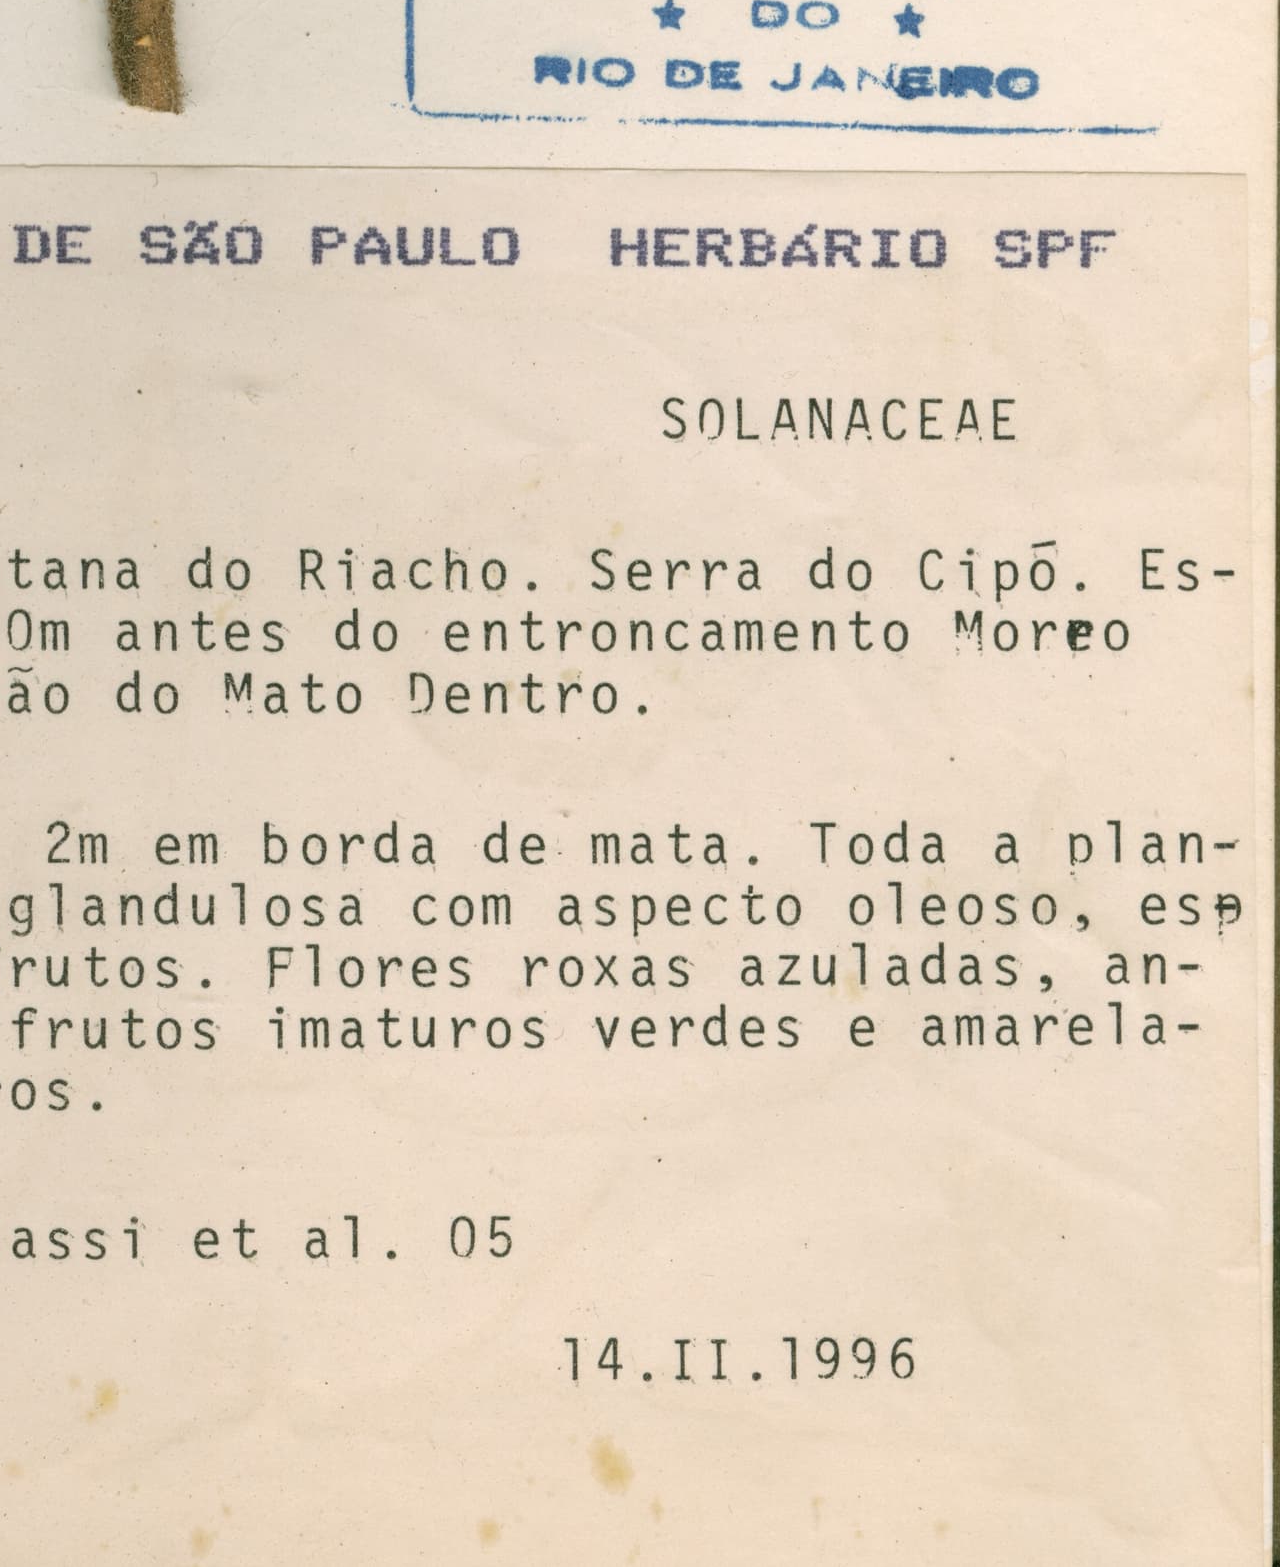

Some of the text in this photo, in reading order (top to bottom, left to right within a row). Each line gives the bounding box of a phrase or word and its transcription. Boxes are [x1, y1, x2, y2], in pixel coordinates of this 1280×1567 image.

[752, 0, 840, 29] DO
[534, 57, 1040, 101] RIO DE JANEIRO
[13, 225, 91, 264] DE
[140, 221, 262, 265] SÃO
[312, 226, 520, 266] PAULO
[610, 224, 947, 268] HERBÁRIO
[995, 230, 1116, 268] SPF
[663, 397, 1015, 441] SOLANACEAE
[188, 546, 250, 591] do
[300, 547, 537, 591] Riacho.
[591, 548, 761, 591] Serra
[809, 546, 872, 591] do
[1141, 548, 1235, 592] Es-
[117, 611, 284, 652] antes
[335, 608, 398, 652] do
[444, 611, 908, 652] entroncamento
[116, 670, 179, 714] do
[224, 672, 361, 714] Mato
[409, 672, 647, 715] Dentro.
[47, 820, 108, 864] 2m
[155, 833, 218, 865] em
[264, 820, 435, 866] borda
[483, 821, 545, 865] de
[591, 824, 758, 867] mata.
[810, 820, 945, 865] Toda
[995, 832, 1019, 864] a
[1069, 820, 1240, 866] plan-
[9, 882, 363, 937] glandulosa
[413, 894, 511, 927] com
[558, 885, 801, 937] aspecto
[849, 881, 1090, 932] oleoso,
[267, 944, 470, 989] Flores
[523, 955, 689, 987] roxas
[741, 942, 1053, 993] azuladas,
[1106, 953, 1199, 985] an-
[12, 1007, 215, 1050] frutos
[269, 1006, 544, 1049] imaturos
[595, 1003, 799, 1049] verdes
[850, 1015, 875, 1047] e
[923, 1002, 1199, 1047] amarela-
[194, 1219, 258, 1259] et
[306, 1215, 396, 1260] al.
[564, 1337, 914, 1382] 14.II.1996
